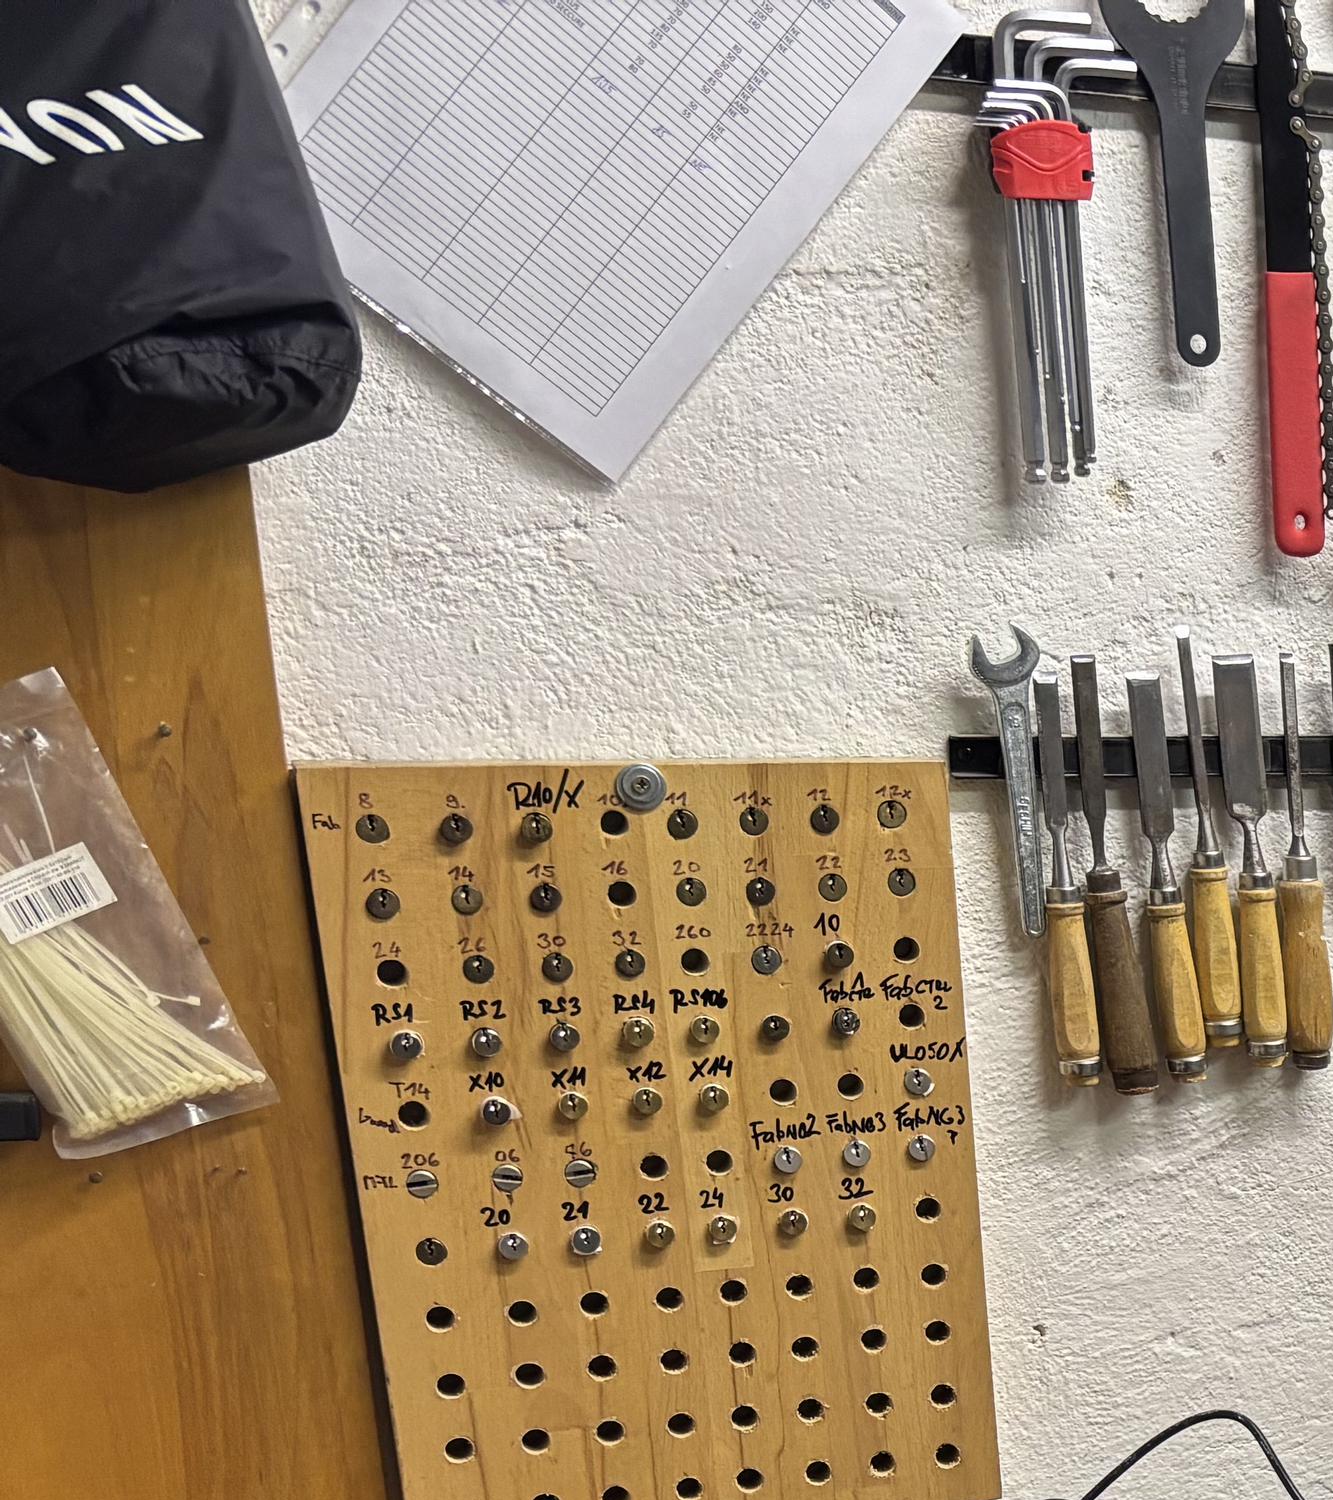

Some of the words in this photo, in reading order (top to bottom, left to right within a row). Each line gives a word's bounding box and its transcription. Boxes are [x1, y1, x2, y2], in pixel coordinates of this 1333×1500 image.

[806, 788, 832, 802] 12
[816, 855, 842, 870] 22
[884, 848, 912, 863] 23
[448, 866, 475, 882] 14
[527, 863, 556, 878] 15
[601, 860, 629, 876] 16
[673, 859, 701, 876] 20
[743, 857, 769, 874] 21
[362, 868, 393, 883] 13
[675, 924, 712, 939] 260
[745, 922, 795, 938] 2224
[813, 912, 840, 936] 10
[457, 936, 487, 954] 26
[537, 933, 566, 950] 30
[612, 930, 642, 946] 32
[372, 941, 401, 960] 24
[626, 1061, 667, 1083] X12
[689, 1055, 733, 1082] X14
[469, 1071, 505, 1093] X10
[767, 1183, 794, 1203] 30
[838, 1177, 874, 1200] 32
[638, 1192, 669, 1214] 22
[699, 1187, 725, 1209] 24
[480, 1206, 511, 1227] 20
[561, 1200, 590, 1222] 21
